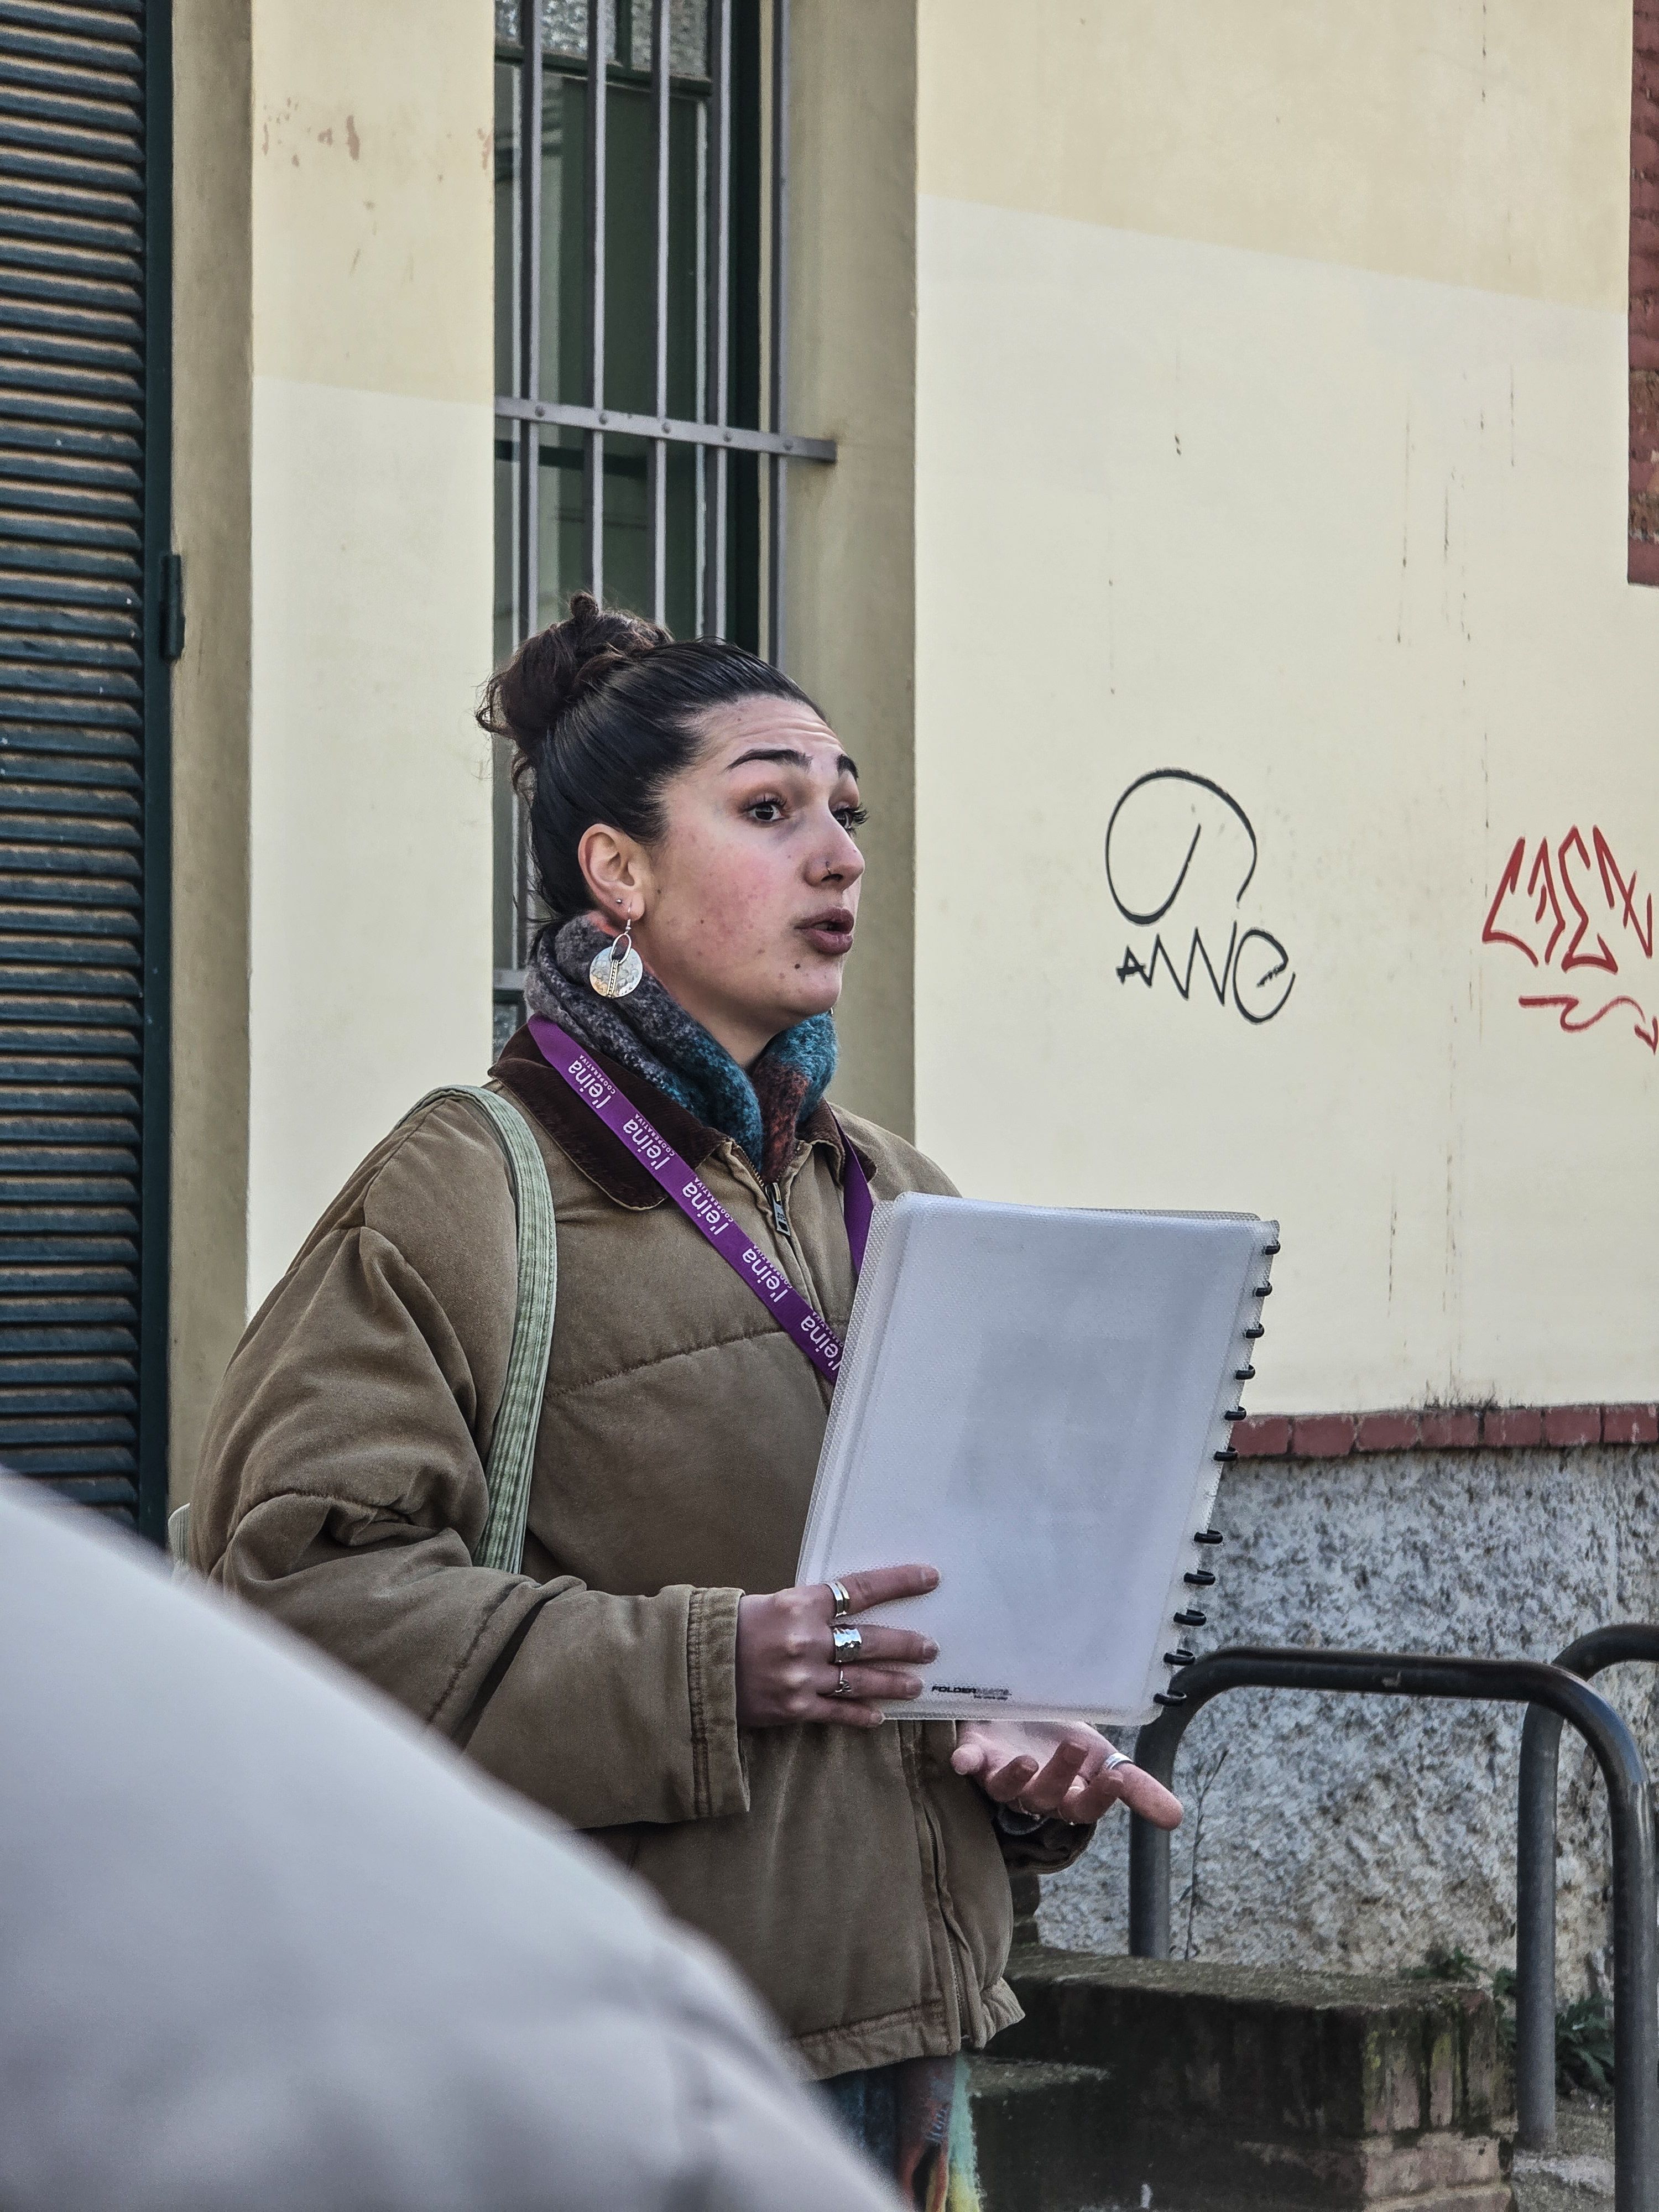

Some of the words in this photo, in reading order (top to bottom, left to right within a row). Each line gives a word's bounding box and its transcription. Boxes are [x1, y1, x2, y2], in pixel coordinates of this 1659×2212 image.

[568, 1060, 612, 1109] l'eina
[579, 1055, 616, 1094] COOPERATIVA
[623, 1119, 670, 1170] l'eina
[634, 1113, 676, 1156] COOPERATIVA
[682, 1182, 729, 1235] l'eina
[694, 1177, 734, 1222] COOPERATIVA
[742, 1248, 789, 1303] l'eina
